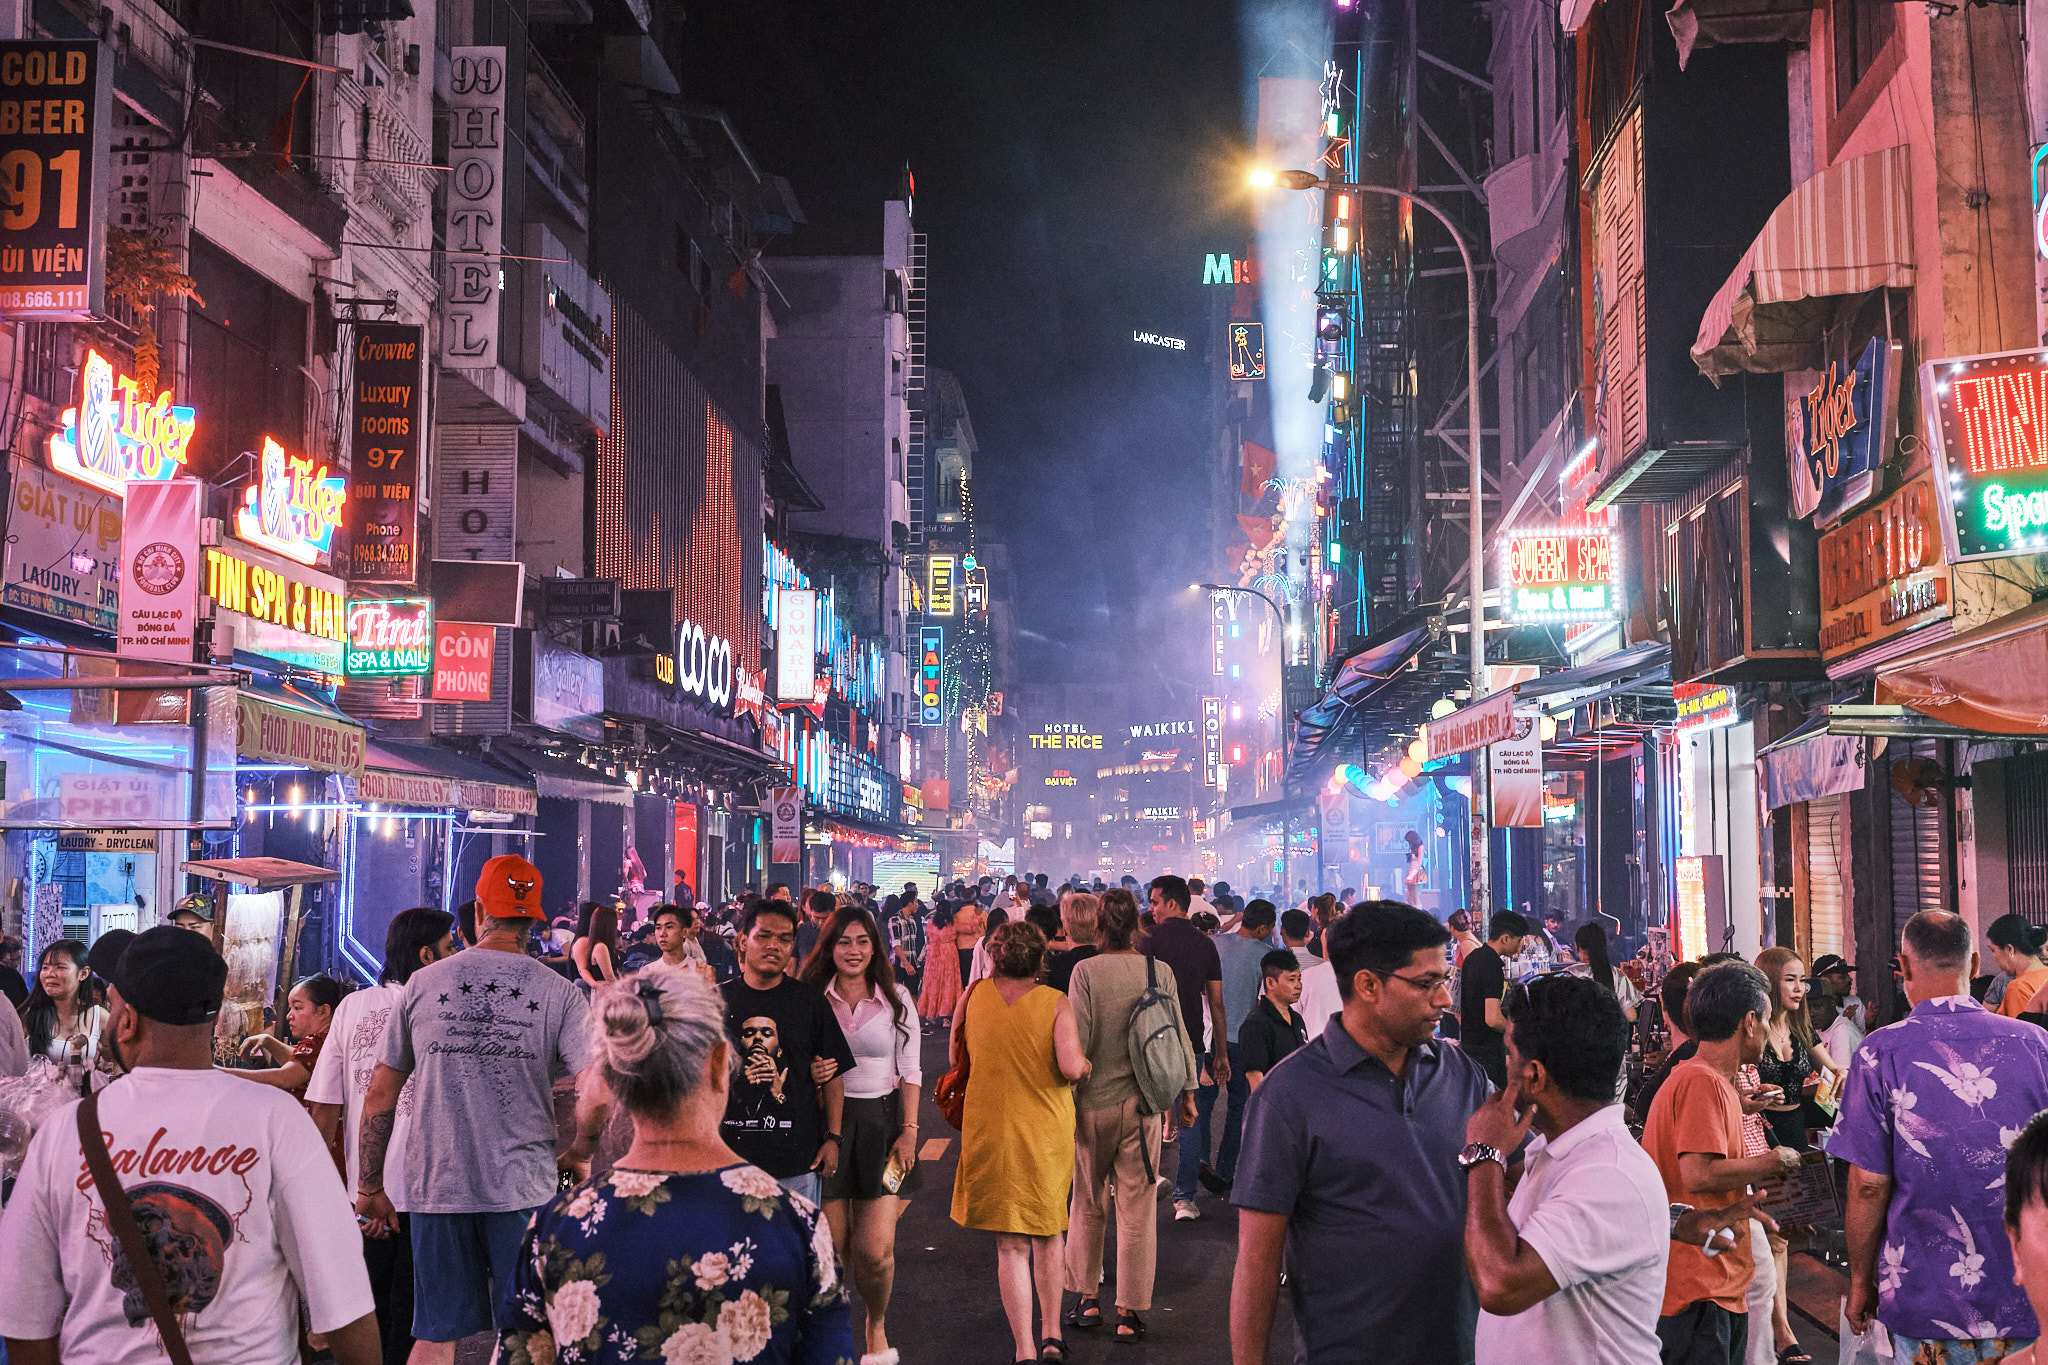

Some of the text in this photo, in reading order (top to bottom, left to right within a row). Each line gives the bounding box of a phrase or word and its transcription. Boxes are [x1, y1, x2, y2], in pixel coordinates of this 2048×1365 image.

[2, 51, 87, 86] COLD
[452, 56, 502, 94] 99
[1, 99, 85, 135] BEER
[0, 149, 81, 231] 91
[449, 106, 500, 356] HOTEL
[2, 243, 83, 278] ÙI VIỆN
[0, 290, 83, 308] 08.666.111
[359, 335, 415, 361] Crowne
[1133, 330, 1186, 351] LANCASTER
[360, 381, 411, 408] Luxury
[118, 374, 196, 478] Tiger
[361, 416, 409, 435] rooms
[1808, 360, 1856, 478] Tiger
[367, 447, 404, 470] 97
[16, 480, 68, 528] GIẶT
[290, 455, 346, 540] Tiger
[382, 483, 411, 502] VIỆN
[366, 522, 400, 536] Phone
[1508, 536, 1612, 585] QUEEN SPA
[22, 563, 80, 598] LAUDRY
[207, 549, 347, 643] TINI SPA & NAIL
[137, 622, 176, 632] BÓNG ĐÁ
[152, 611, 169, 620] LẠC
[170, 610, 182, 620] BỘ
[350, 604, 426, 647] Tini
[150, 636, 166, 645] CHÍ
[440, 630, 489, 659] CÒN
[788, 594, 806, 680] GOMART
[350, 652, 378, 668] SPA
[380, 651, 391, 668] &
[394, 651, 427, 668] NAIL
[656, 654, 674, 684] CLUB
[436, 665, 488, 693] PHÒNG
[556, 660, 585, 706] gallery
[782, 682, 809, 694] 24H
[923, 637, 940, 721] TATTOO
[260, 713, 360, 770] FOOD AND BEER 95
[1029, 734, 1102, 749] THE RICE
[1044, 724, 1086, 734] HOTEL
[1130, 720, 1194, 738] WAIKIKI
[1206, 702, 1219, 783] HOTEL
[360, 774, 450, 803] FOOD AND BEER 97
[460, 784, 532, 811] FOOD AND BEER 99
[1144, 806, 1181, 816] WAIKIK
[60, 838, 97, 848] LAUDRY
[106, 838, 154, 849] DRYCLEAN
[102, 912, 136, 934] TATTOO
[438, 1012, 457, 1021] The
[496, 1016, 534, 1028] Famous
[428, 1041, 537, 1060] Original All Star
